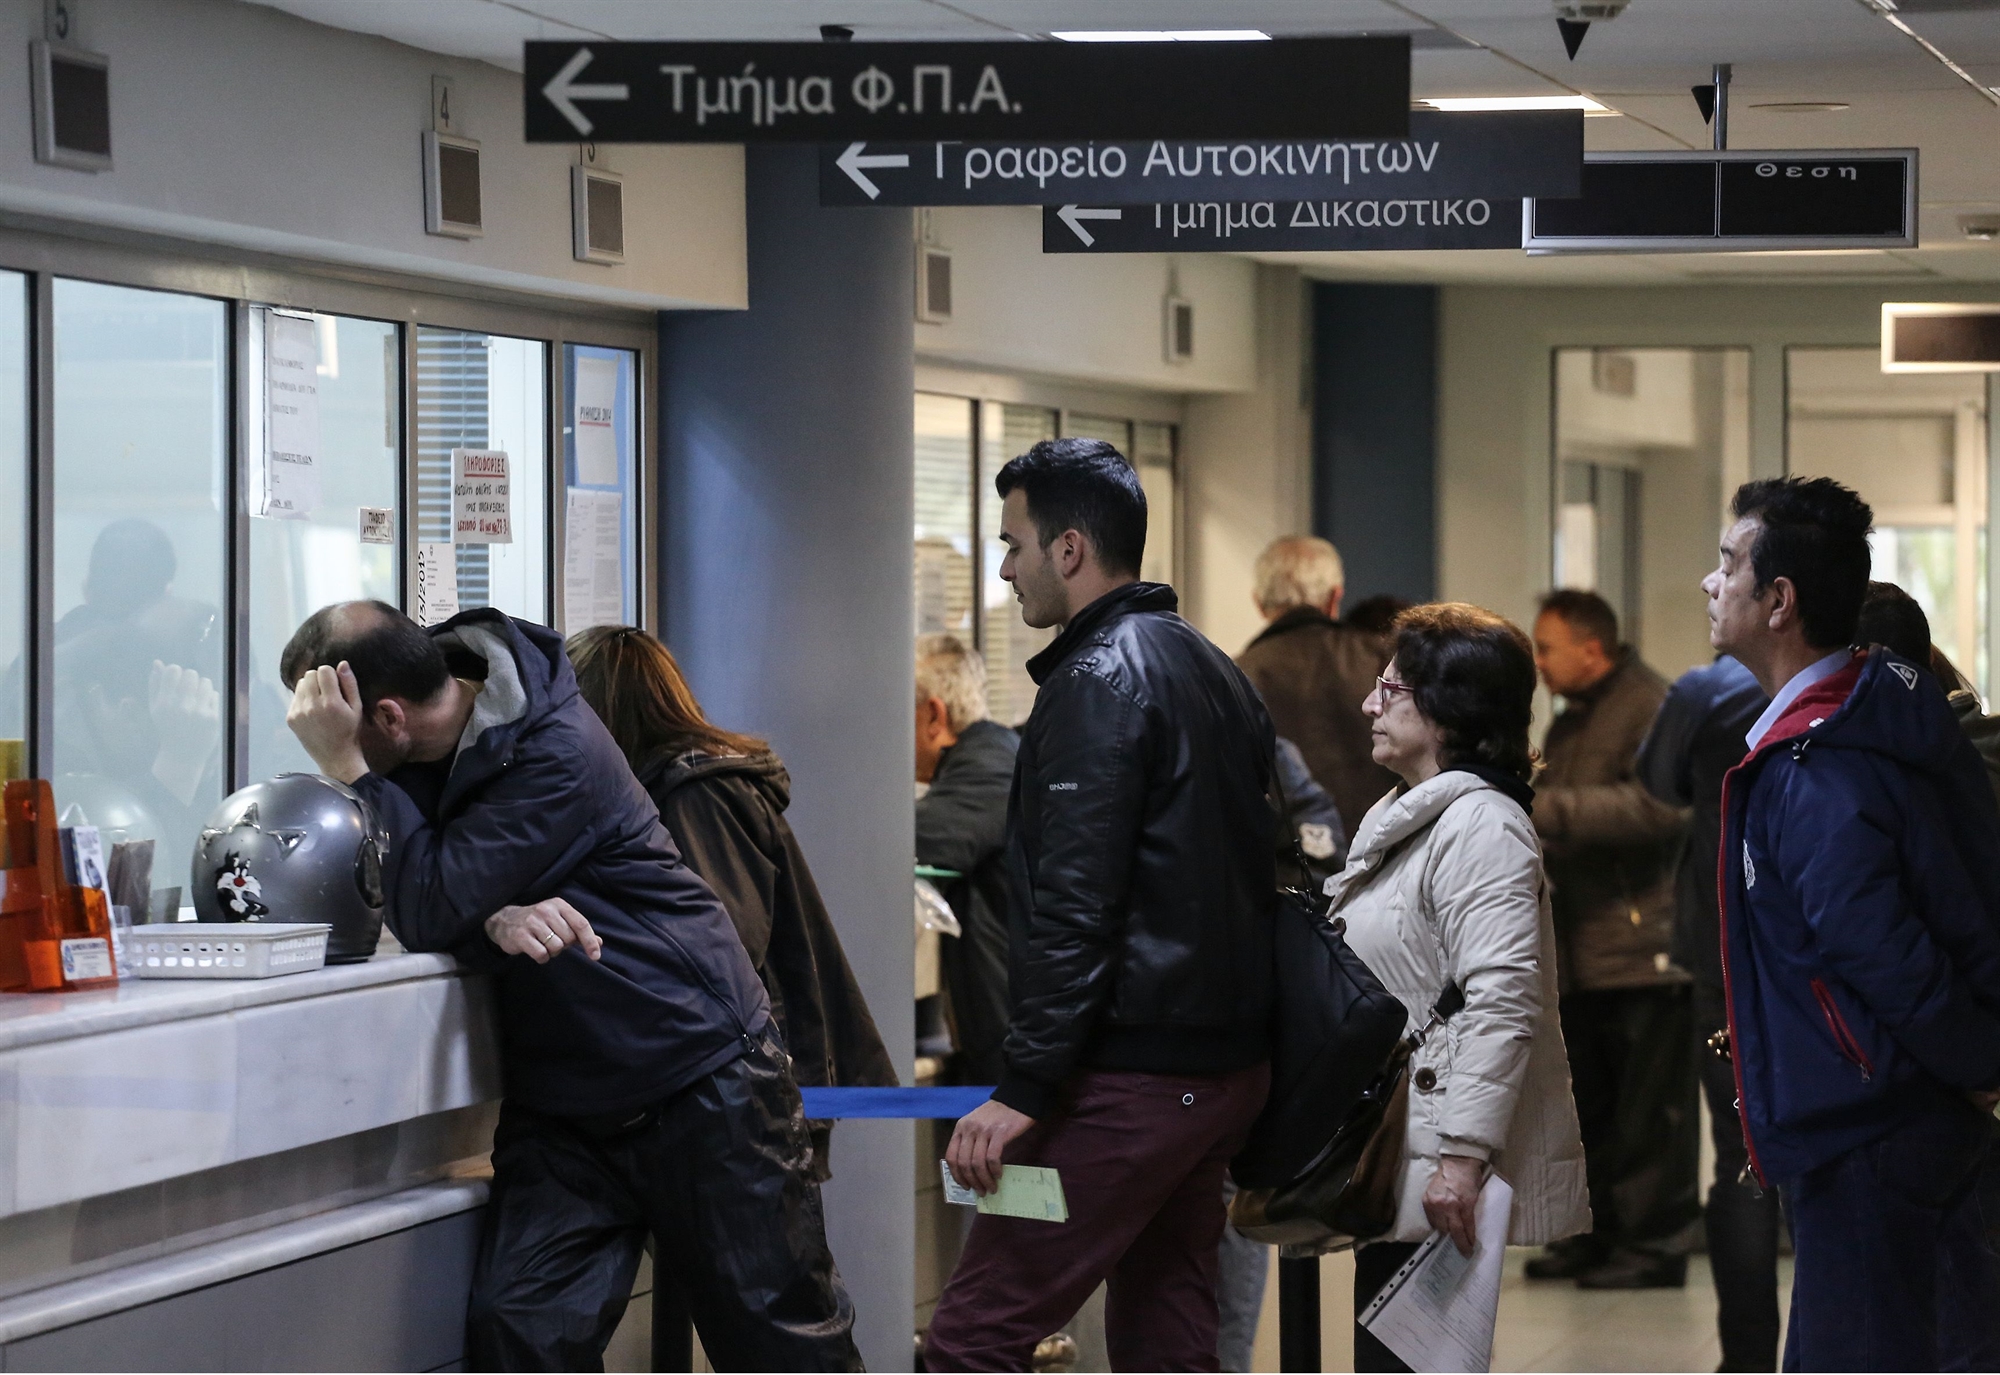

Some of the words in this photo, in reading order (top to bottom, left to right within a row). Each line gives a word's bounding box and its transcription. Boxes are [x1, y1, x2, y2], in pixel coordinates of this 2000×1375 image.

[441, 86, 449, 128] 4
[659, 62, 834, 125] Τμήμα
[852, 64, 1022, 113] Φ.Π.Α.
[1289, 199, 1491, 227] Δικαστικο
